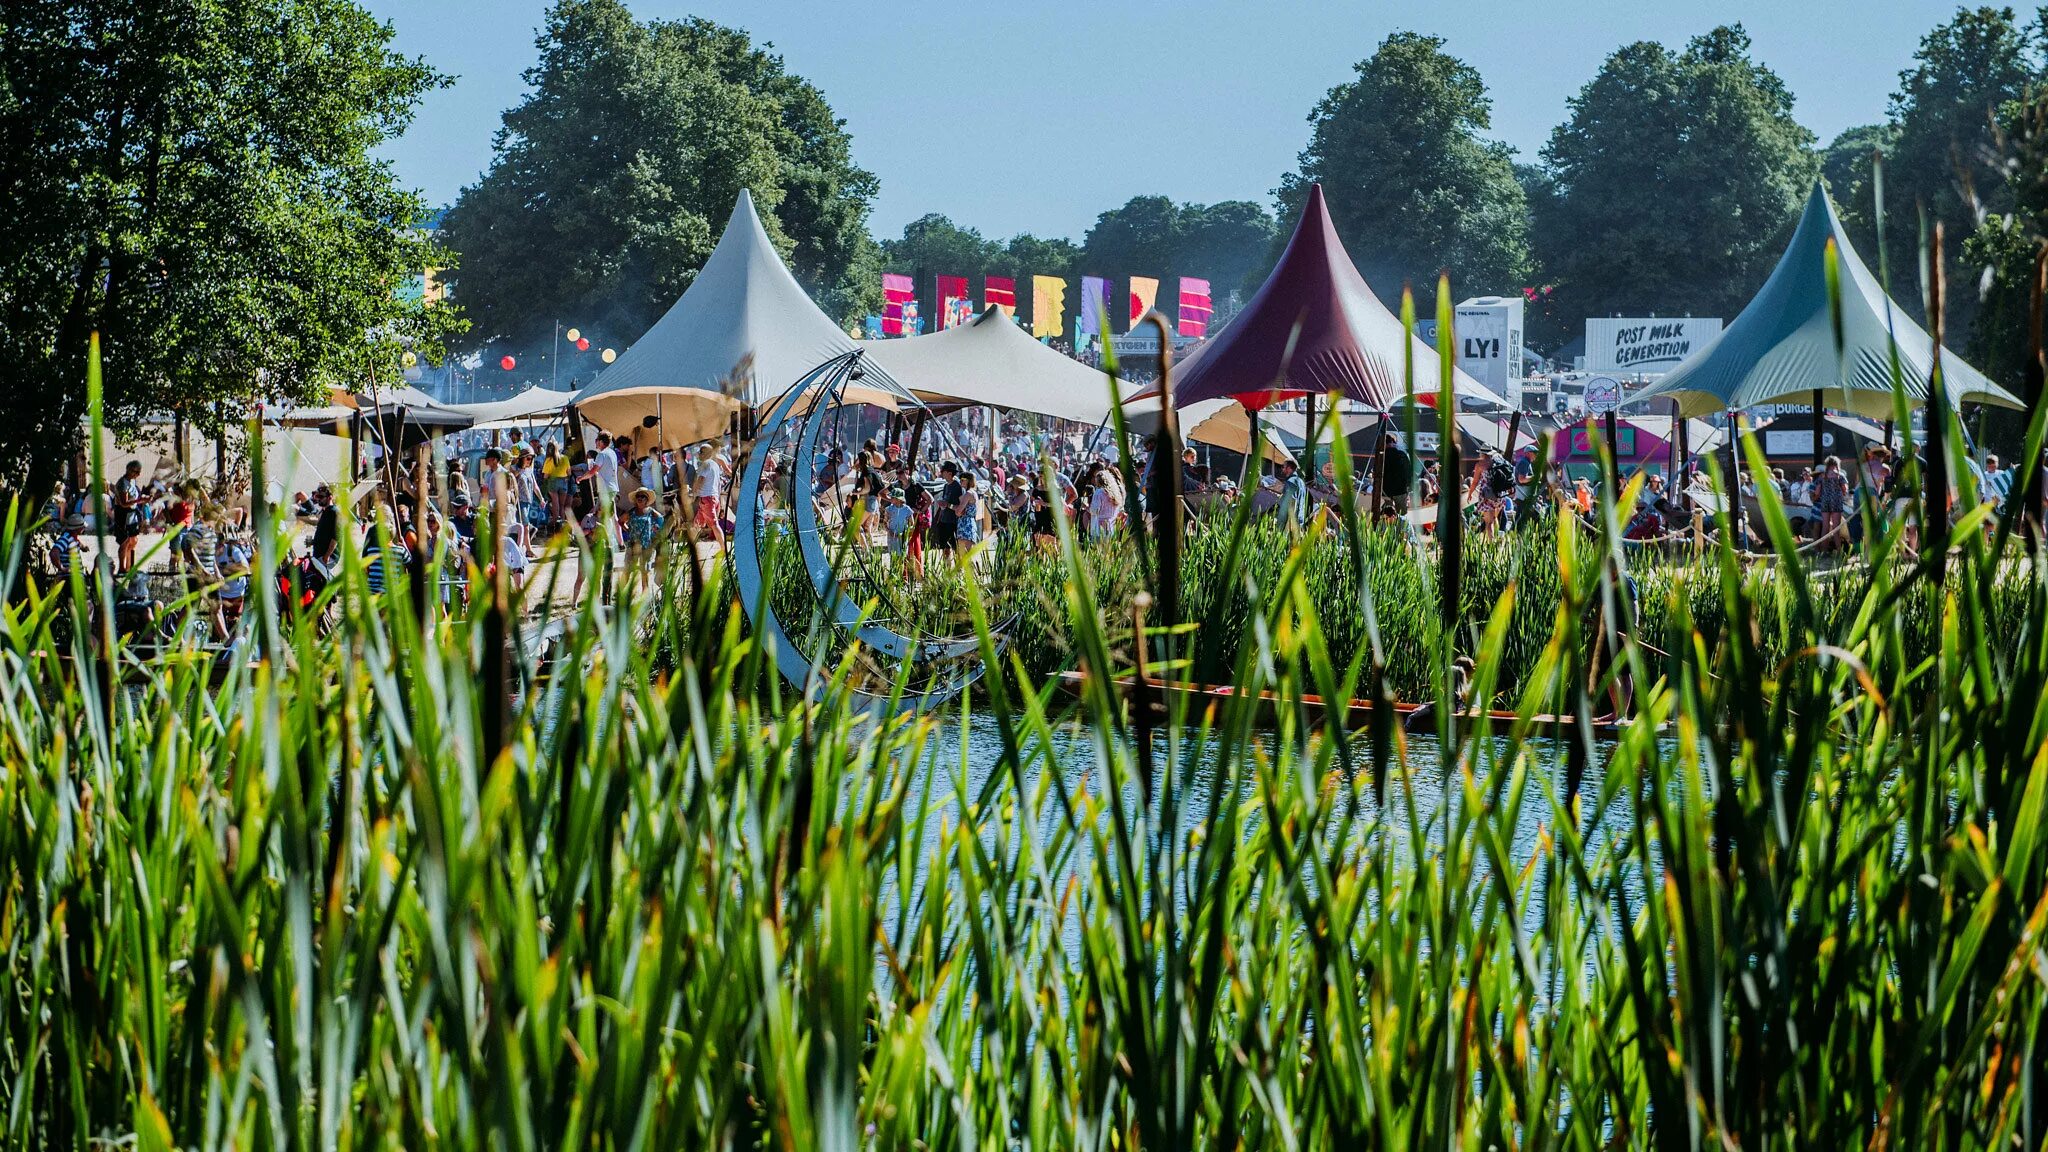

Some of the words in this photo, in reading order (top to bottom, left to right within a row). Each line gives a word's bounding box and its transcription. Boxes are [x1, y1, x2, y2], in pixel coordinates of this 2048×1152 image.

[1616, 326, 1646, 346] POST
[1649, 323, 1684, 340] MILK
[1465, 338, 1499, 358] LY!
[1616, 341, 1690, 364] GENERATION
[1776, 403, 1815, 414] BURGE
